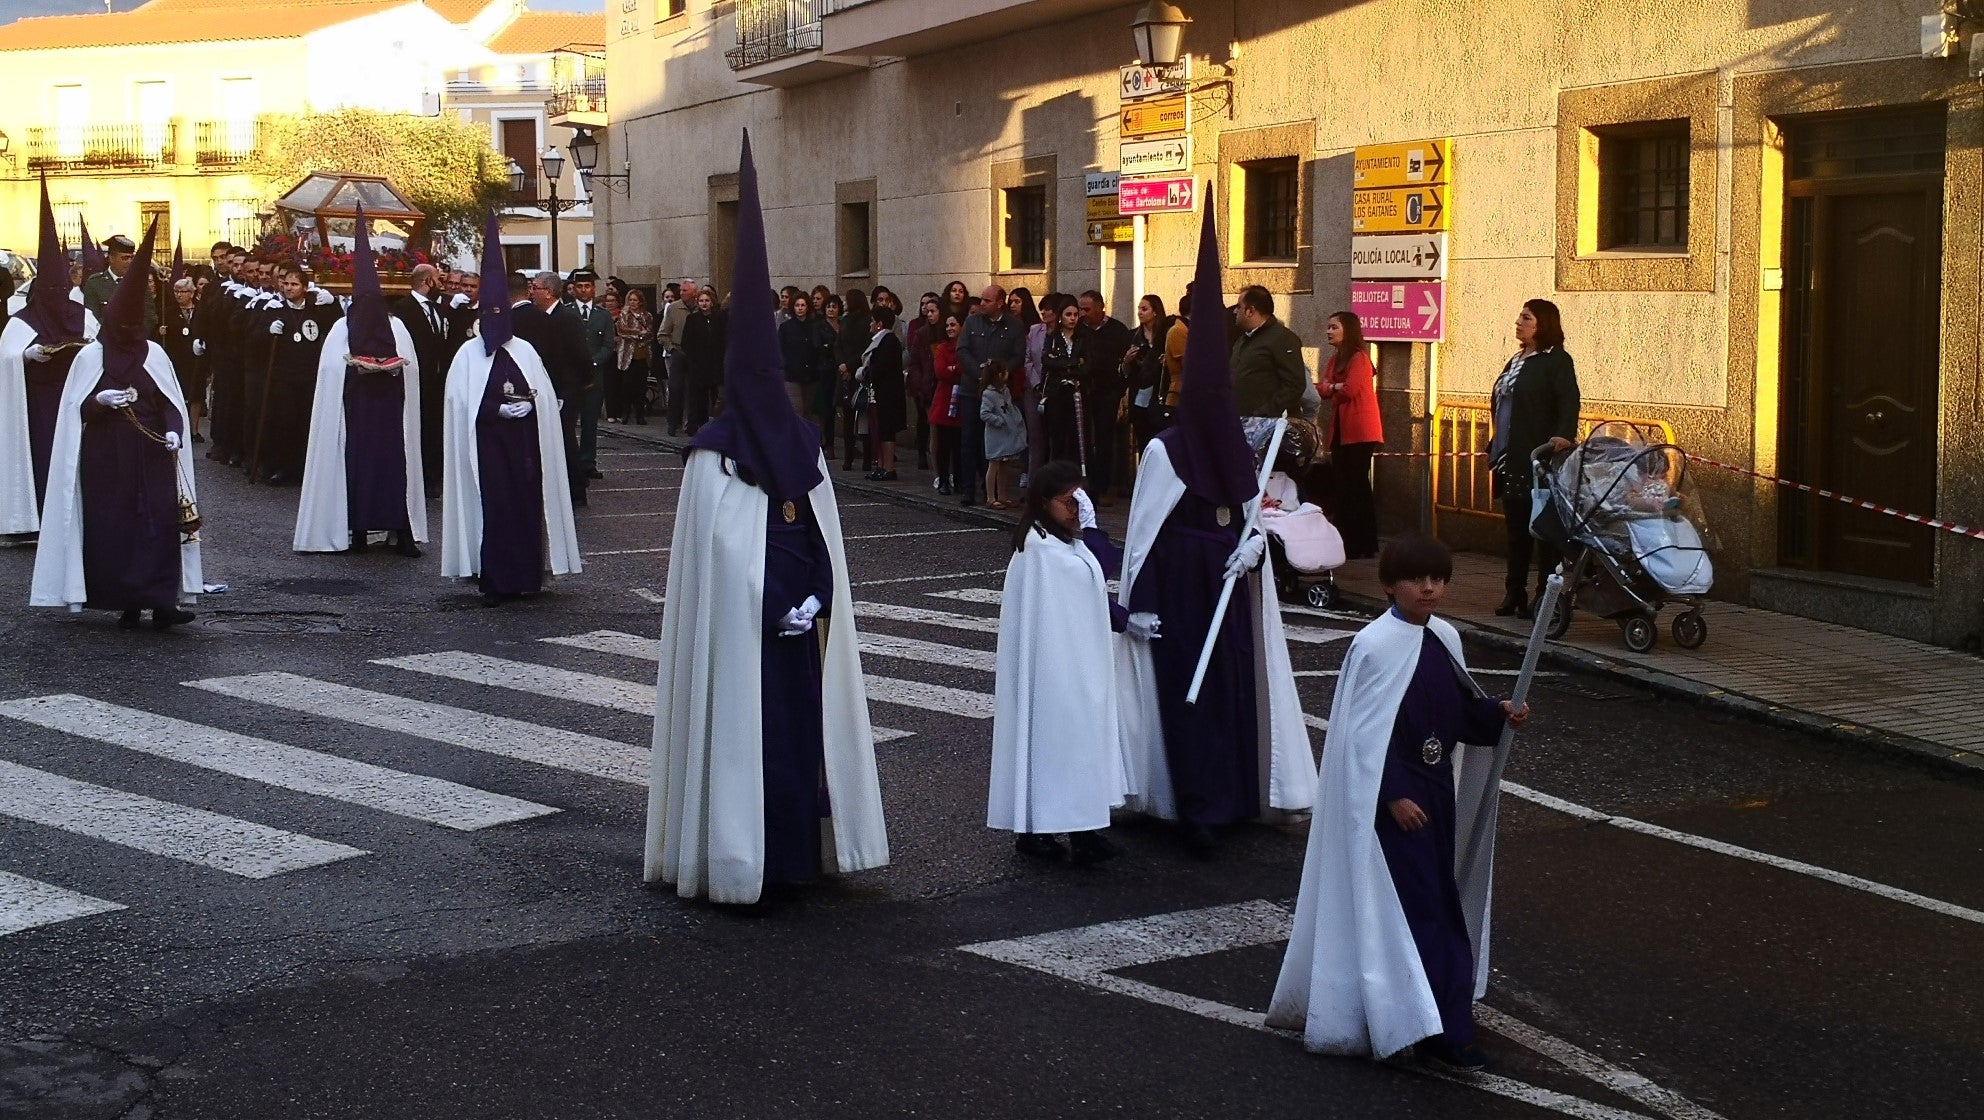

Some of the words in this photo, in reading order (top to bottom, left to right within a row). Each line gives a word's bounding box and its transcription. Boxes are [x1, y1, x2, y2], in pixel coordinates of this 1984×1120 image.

[1160, 111, 1184, 121] correos
[1122, 151, 1163, 166] ayuntamiento
[1355, 156, 1400, 170] AYUNTAMIENTO
[1087, 178, 1110, 193] guardia
[1354, 193, 1371, 205] CASA
[1372, 192, 1394, 204] RURAL
[1354, 206, 1366, 218] LOS
[1368, 205, 1398, 217] GAITANES
[1353, 247, 1382, 265] POLICÍA
[1385, 249, 1411, 264] LOCAL
[1352, 291, 1390, 303] BIBLIOTECA
[1360, 316, 1368, 328] SA
[1369, 316, 1379, 328] DE
[1380, 316, 1411, 329] CULTURA
